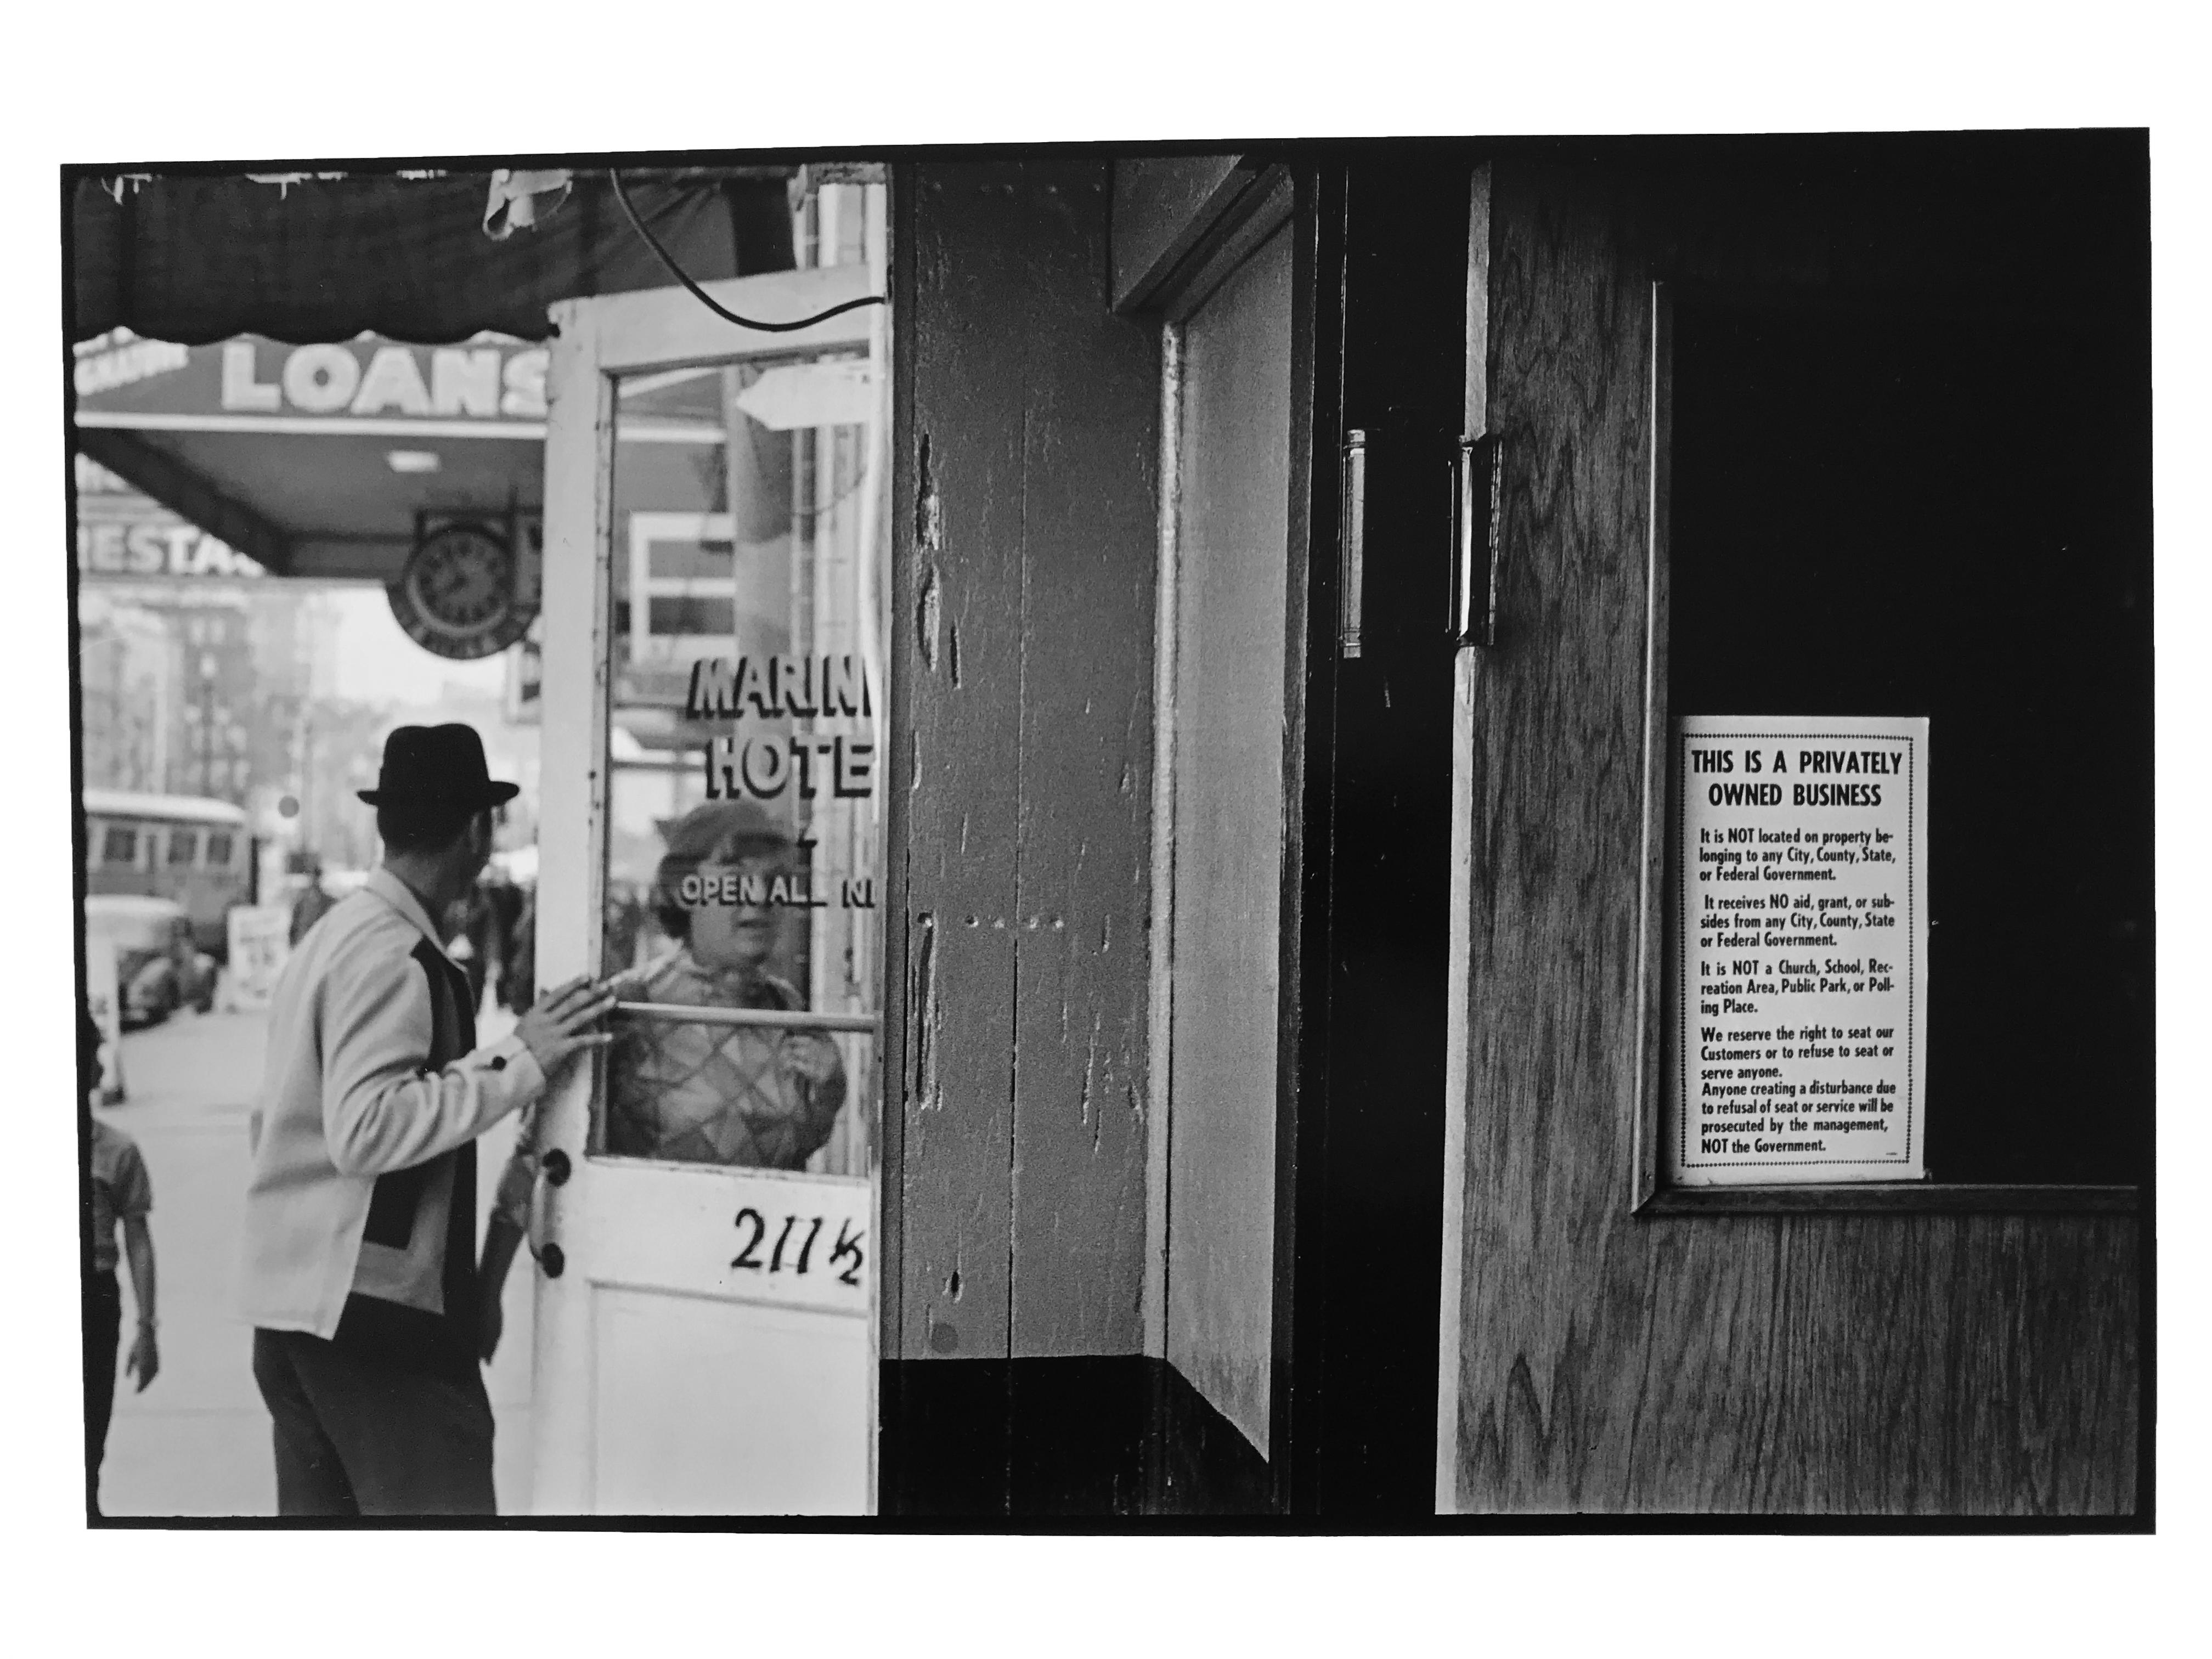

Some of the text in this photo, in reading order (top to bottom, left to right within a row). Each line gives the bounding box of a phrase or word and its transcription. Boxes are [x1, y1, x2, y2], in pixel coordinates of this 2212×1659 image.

[222, 341, 549, 416] LOANS
[78, 528, 266, 576] ESTA
[686, 655, 871, 719] MARIN
[1691, 749, 1903, 775] THIS IS A PRIVATELY
[1708, 783, 1882, 806] OWNED BUSINESS
[1700, 827, 1894, 847] It is NOT located on property be-
[1699, 846, 1896, 866] longing to any City, County, State,
[1699, 865, 1836, 882] or Federal Government.
[681, 874, 763, 907] OPEN
[768, 875, 827, 909] ALL
[1705, 893, 1895, 912] It receives NO aid, grant, or sub-
[1700, 911, 1895, 931] sides from any City, County, State
[1700, 931, 1837, 948] or Federal Government.
[1701, 958, 1893, 977] It is NOT a Church, School, Rec-
[1701, 977, 1894, 996] reation Area, Public Park, or Poll-
[1700, 998, 1758, 1017] ing Place.
[1701, 1024, 1894, 1042] We reserve the right to seat our
[1701, 1043, 1894, 1062] Customers or to refuse to seat or
[1701, 1068, 1782, 1080] serve anyone.
[1701, 1079, 1897, 1099] Anyone creating a disturbance due
[1701, 1097, 1894, 1115] to refusal of seat or service will be
[1701, 1116, 1888, 1136] prosecuted by the management,
[1701, 1138, 1826, 1154] NOT the Government.
